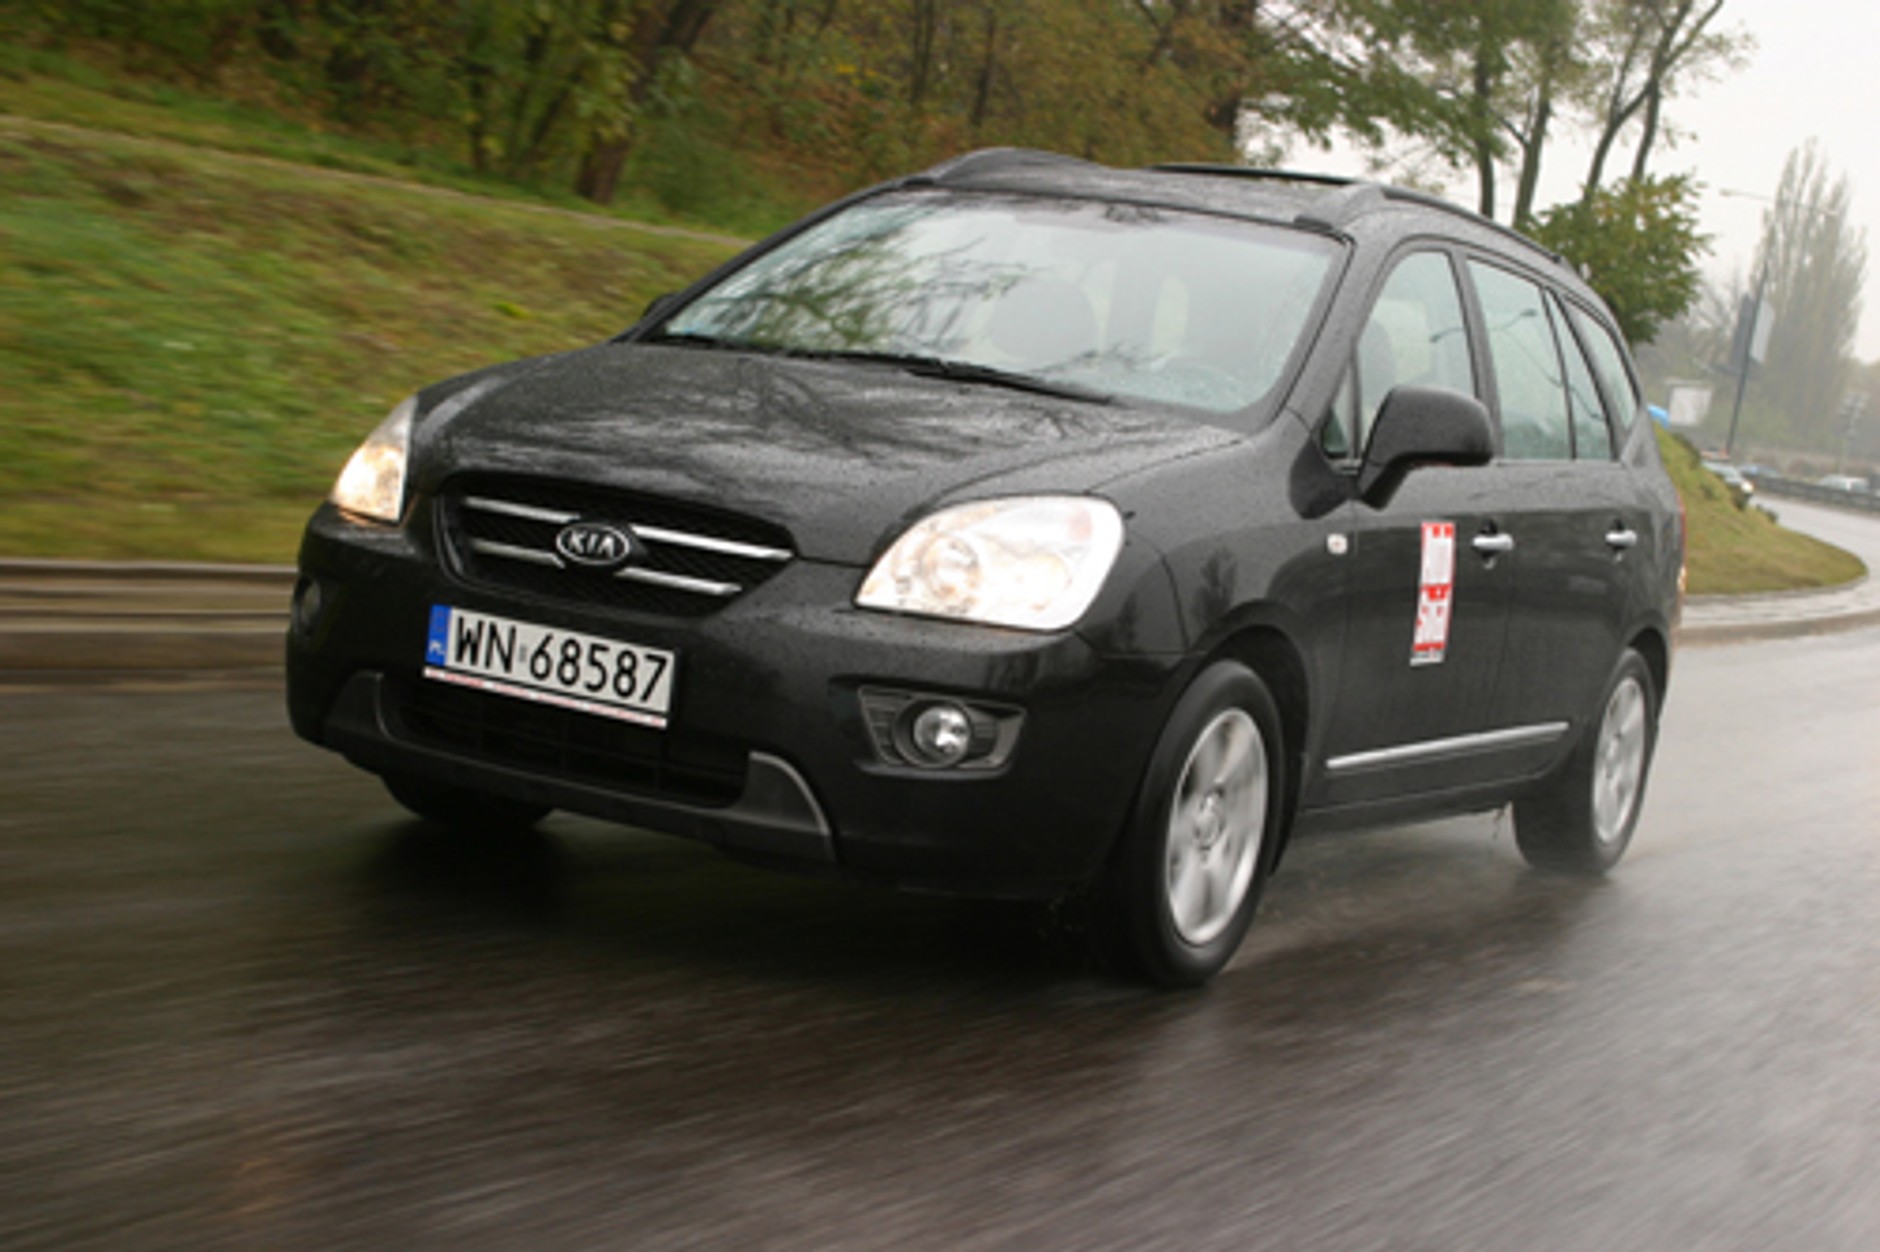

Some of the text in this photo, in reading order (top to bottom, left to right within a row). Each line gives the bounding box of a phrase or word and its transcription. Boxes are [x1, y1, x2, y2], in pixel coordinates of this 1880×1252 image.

[567, 526, 616, 556] KIA
[455, 615, 517, 673] WN
[530, 634, 668, 702] 68587
